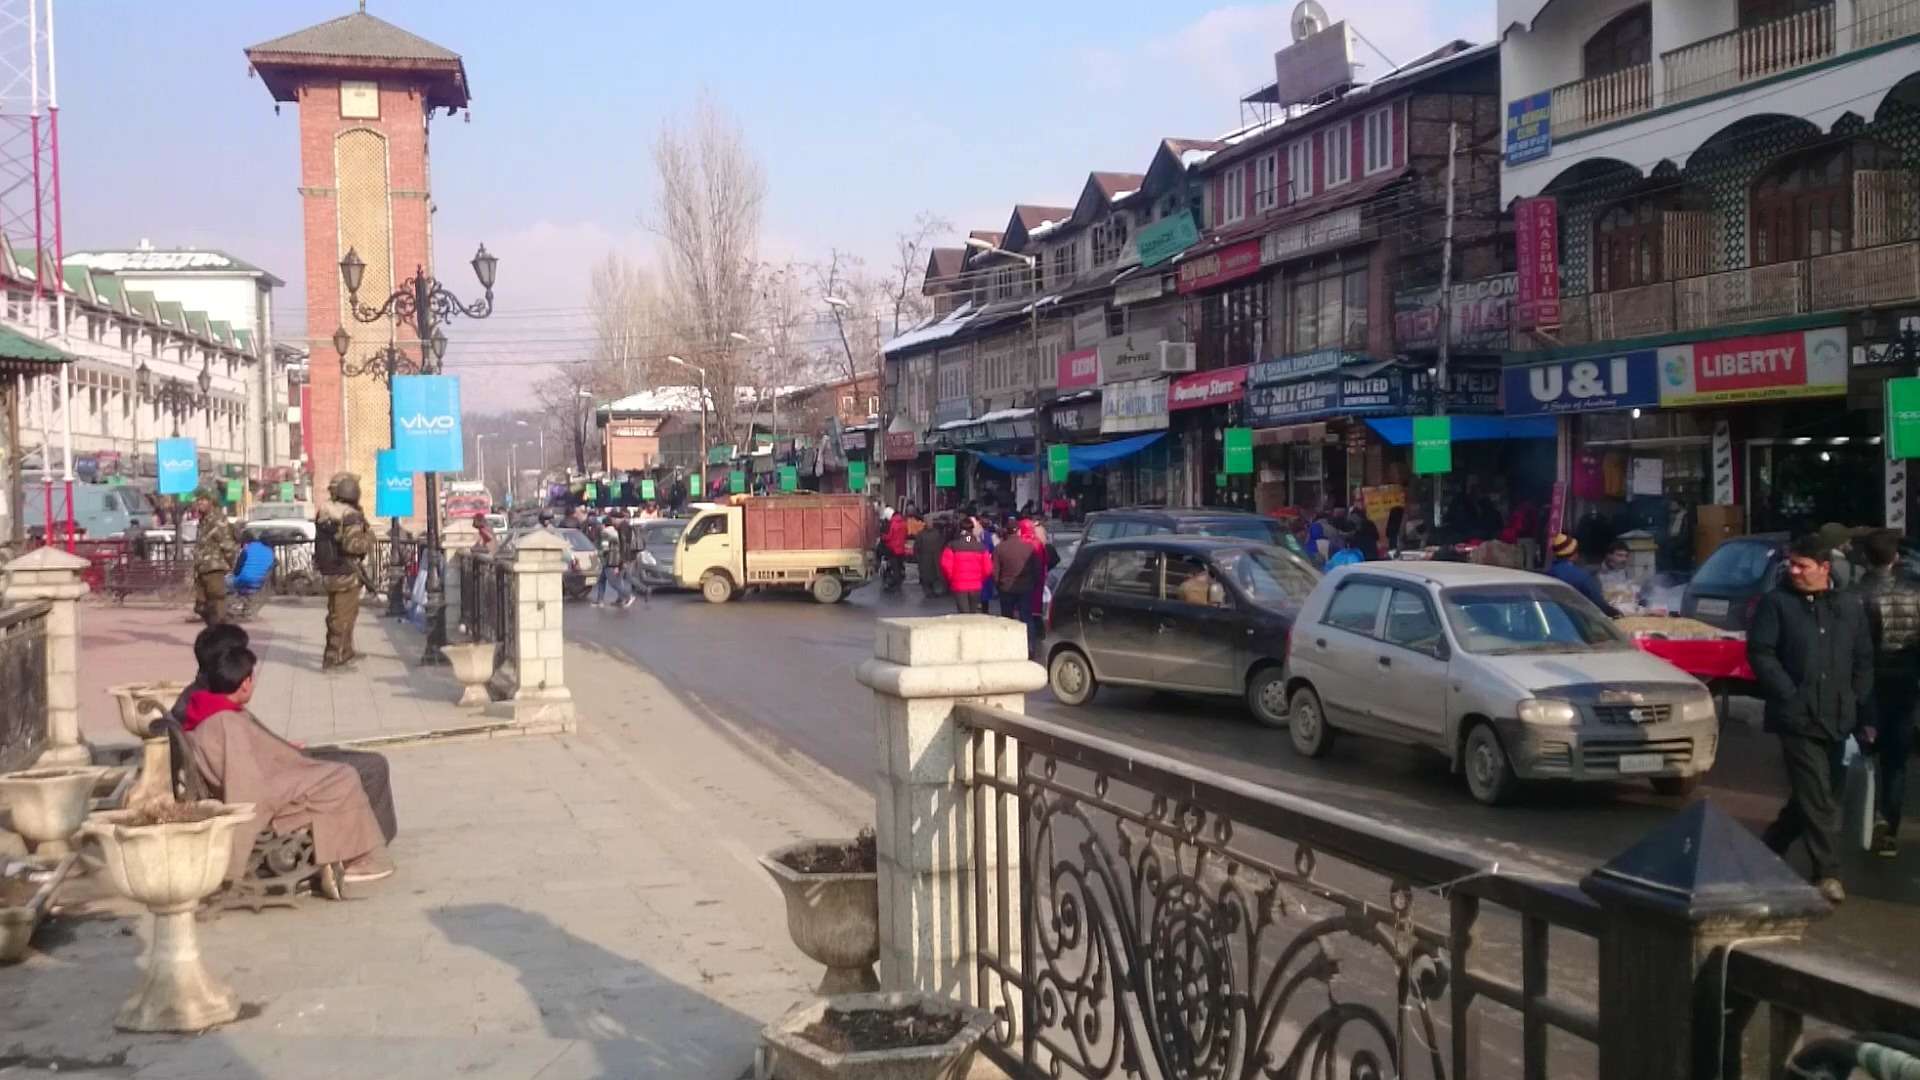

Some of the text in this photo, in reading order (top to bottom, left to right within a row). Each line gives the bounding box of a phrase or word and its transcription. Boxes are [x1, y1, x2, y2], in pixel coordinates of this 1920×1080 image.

[1538, 216, 1554, 298] KASHMIR
[1449, 275, 1520, 301] ELCOM
[1701, 347, 1797, 378] LIBERTY
[1343, 378, 1389, 395] UNITED
[1411, 372, 1497, 393] UTED
